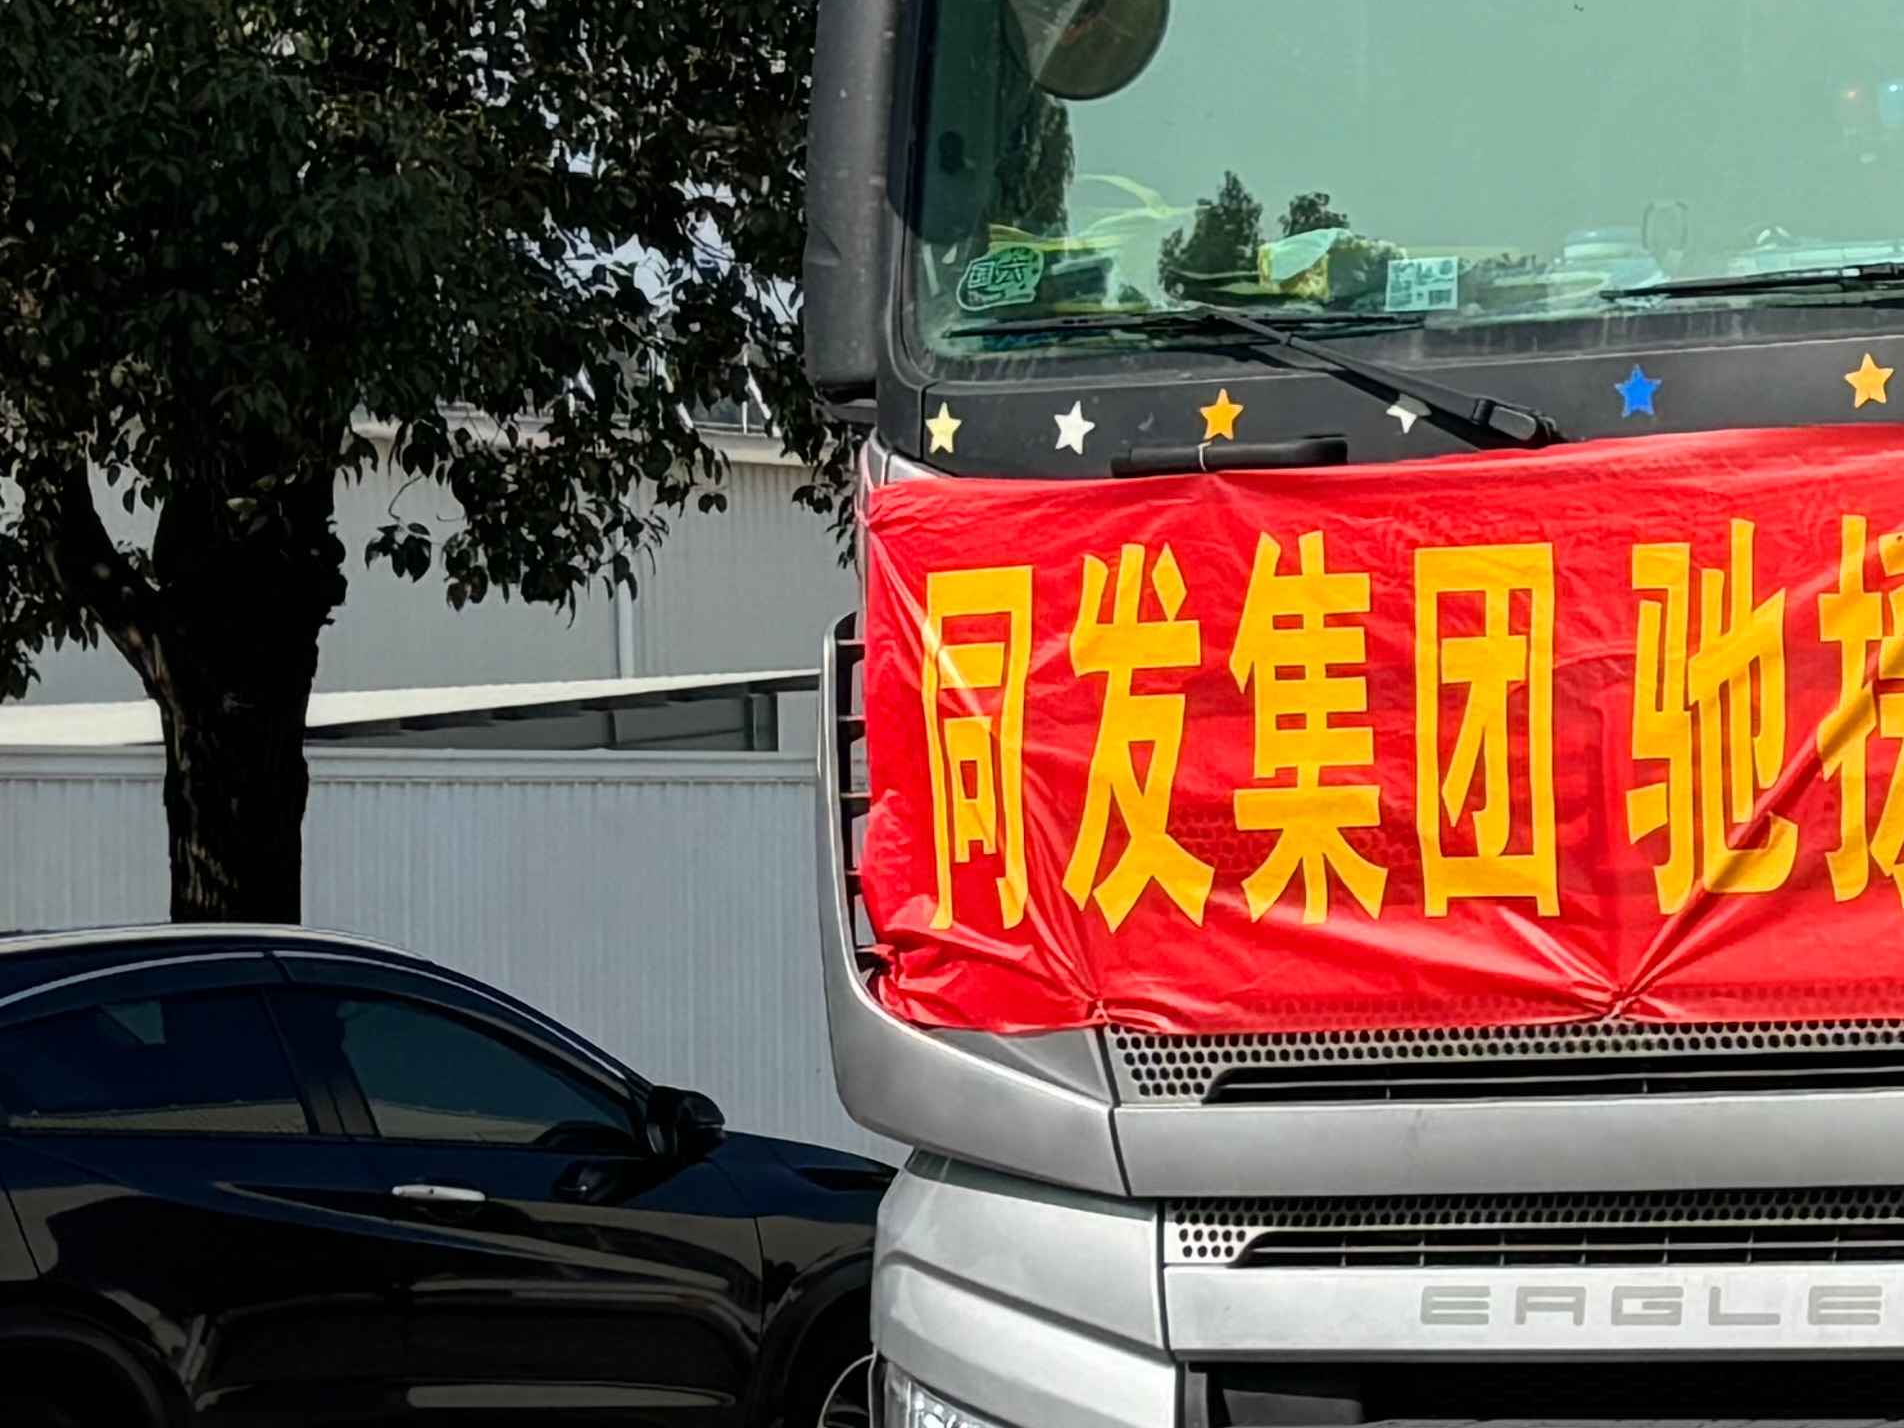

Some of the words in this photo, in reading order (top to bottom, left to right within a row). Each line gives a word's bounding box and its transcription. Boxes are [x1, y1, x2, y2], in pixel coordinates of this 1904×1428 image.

[921, 529, 1562, 933] 同发集团
[1420, 1285, 1882, 1325] EAGLE
